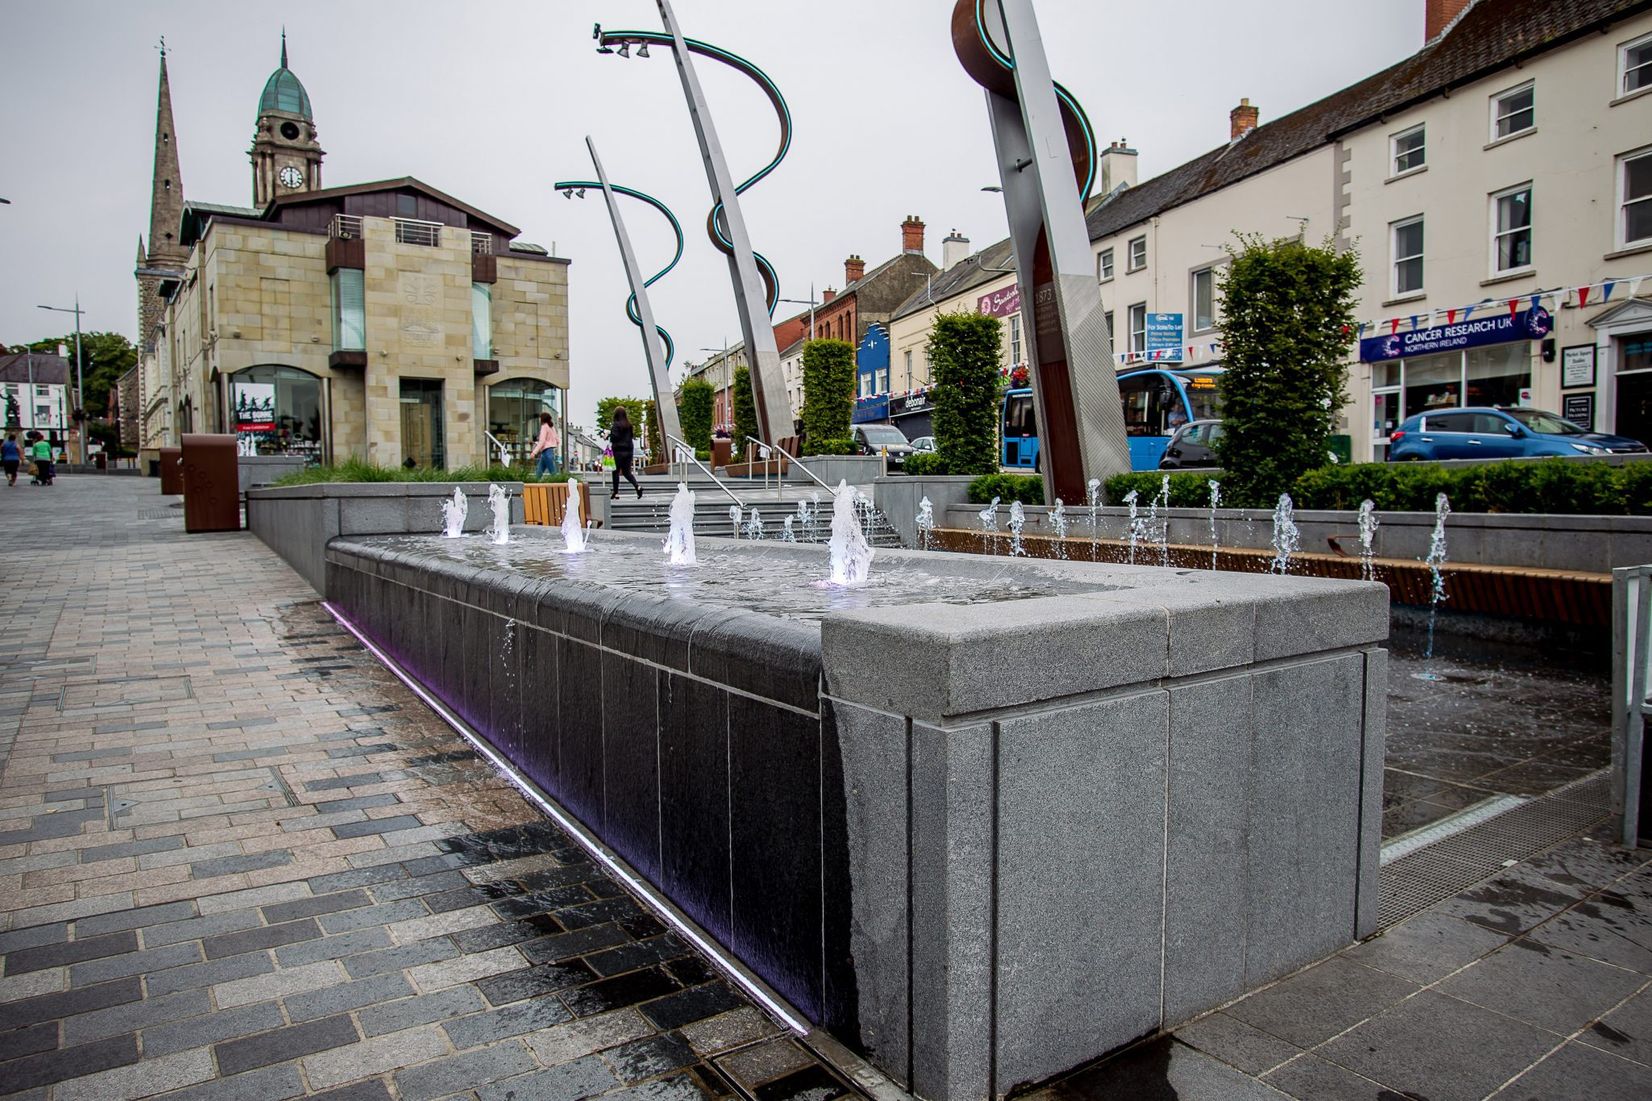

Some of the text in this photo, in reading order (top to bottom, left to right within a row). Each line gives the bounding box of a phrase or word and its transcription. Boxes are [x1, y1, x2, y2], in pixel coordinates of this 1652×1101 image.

[1035, 288, 1053, 304] 1873
[1404, 318, 1513, 344] CANCER RESEARCH UK
[1404, 336, 1468, 353] NORTHERN IRELAND
[905, 395, 926, 408] debonair
